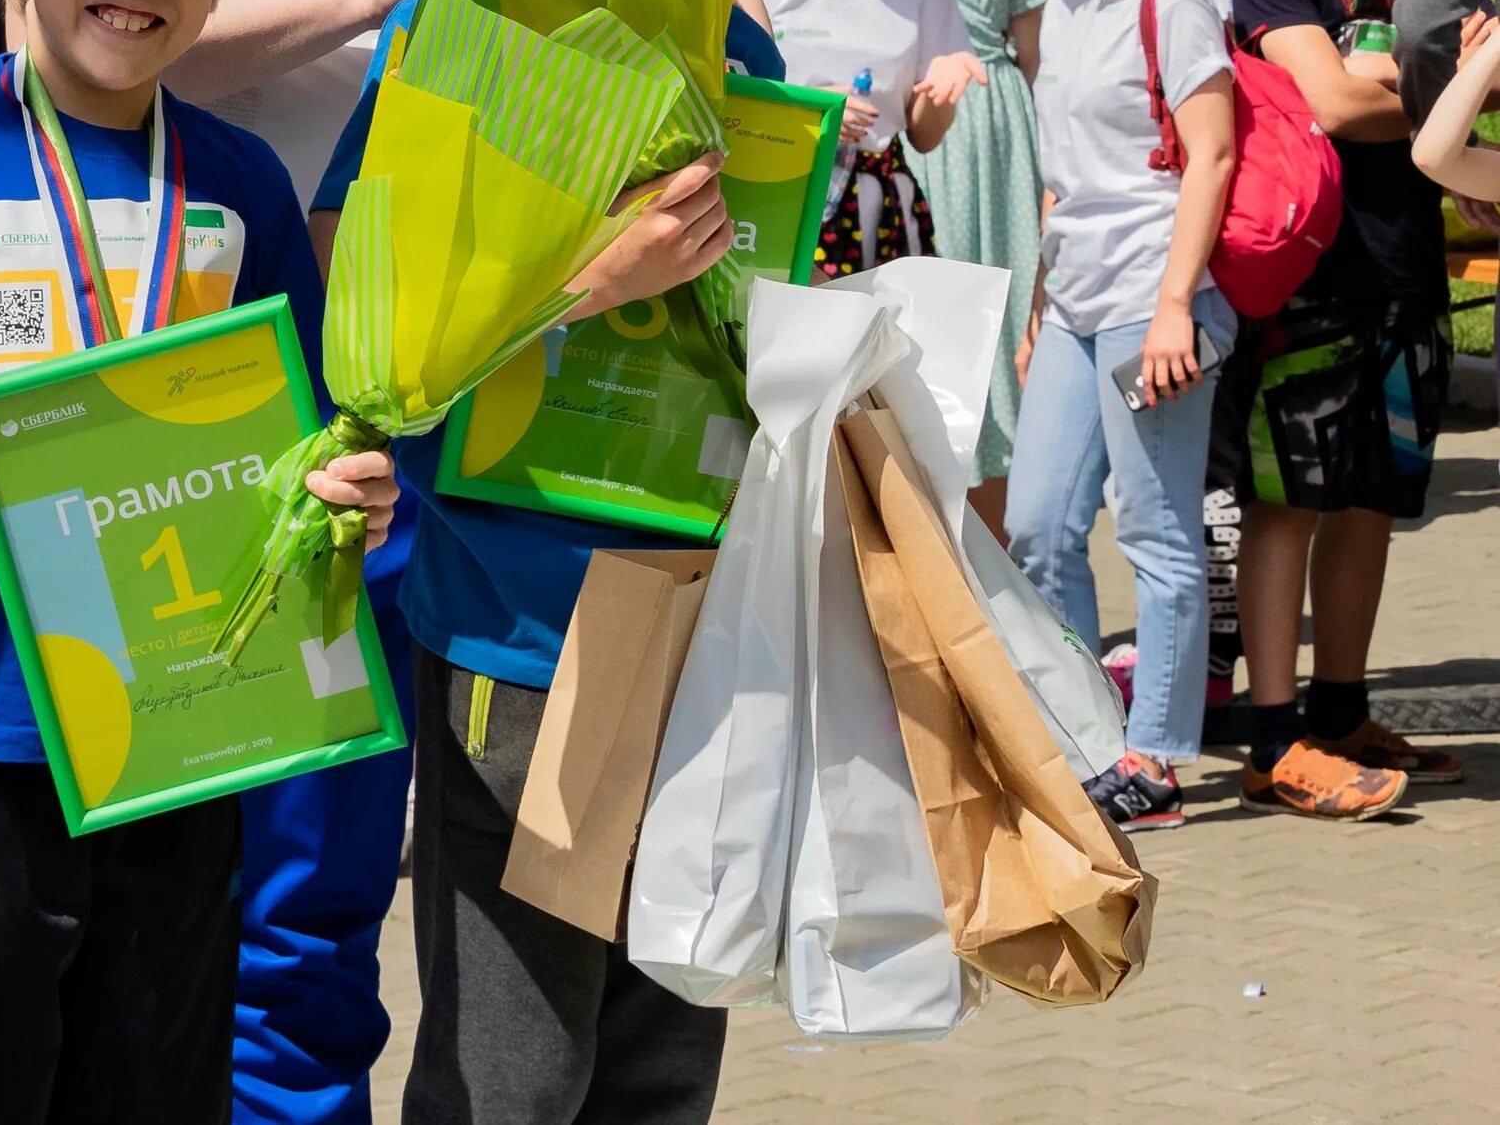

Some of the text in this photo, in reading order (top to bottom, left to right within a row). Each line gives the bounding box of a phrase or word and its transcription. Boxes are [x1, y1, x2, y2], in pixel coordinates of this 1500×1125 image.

[587, 377, 659, 400] Награждается
[20, 401, 87, 428] СБЕРБАНК
[55, 453, 267, 538] Грамота
[625, 483, 645, 496] 2019
[140, 524, 222, 621] 1
[252, 736, 273, 751] 2019
